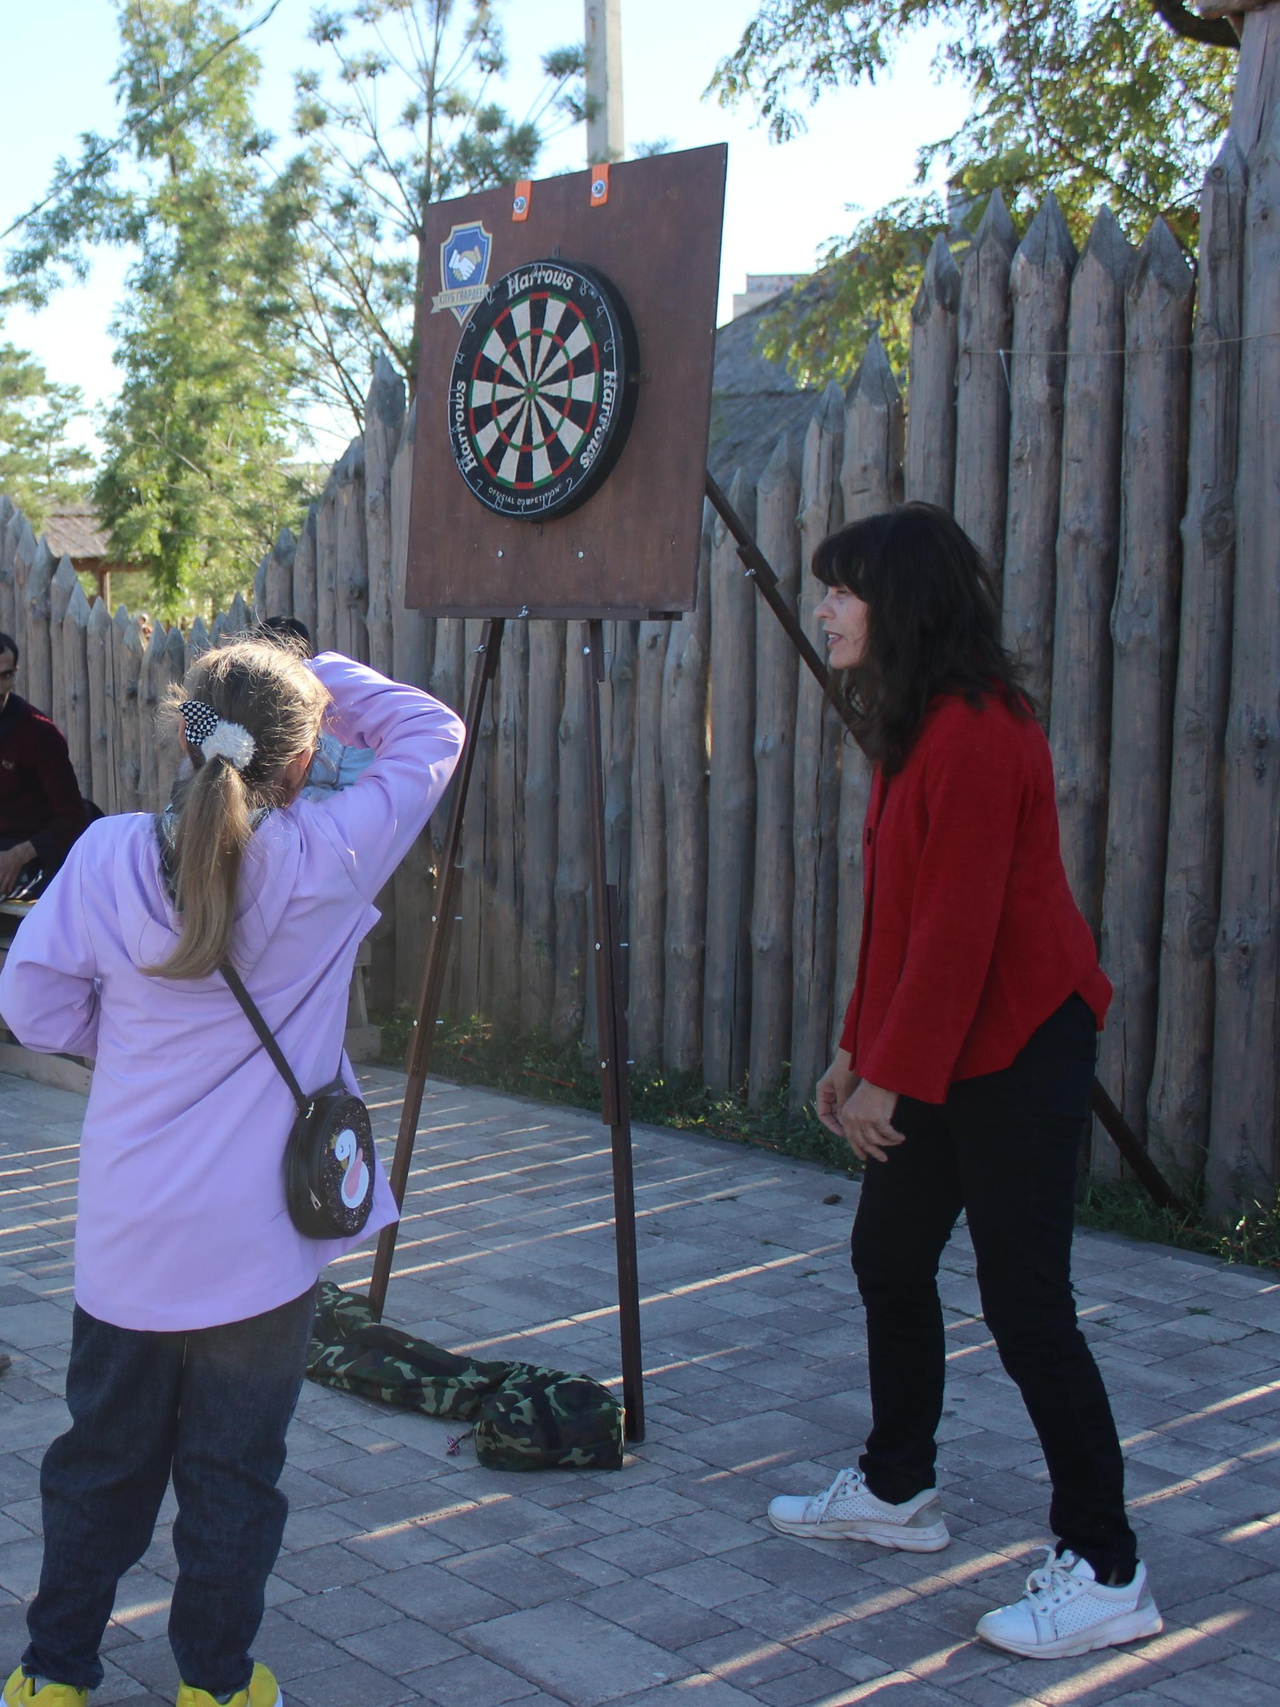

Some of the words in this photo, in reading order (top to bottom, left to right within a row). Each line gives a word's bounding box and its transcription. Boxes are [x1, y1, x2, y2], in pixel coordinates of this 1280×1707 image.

[439, 293, 456, 304] КЛУБ
[507, 269, 574, 299] Harrows
[455, 380, 479, 474] Harrows
[579, 368, 617, 469] Harrows
